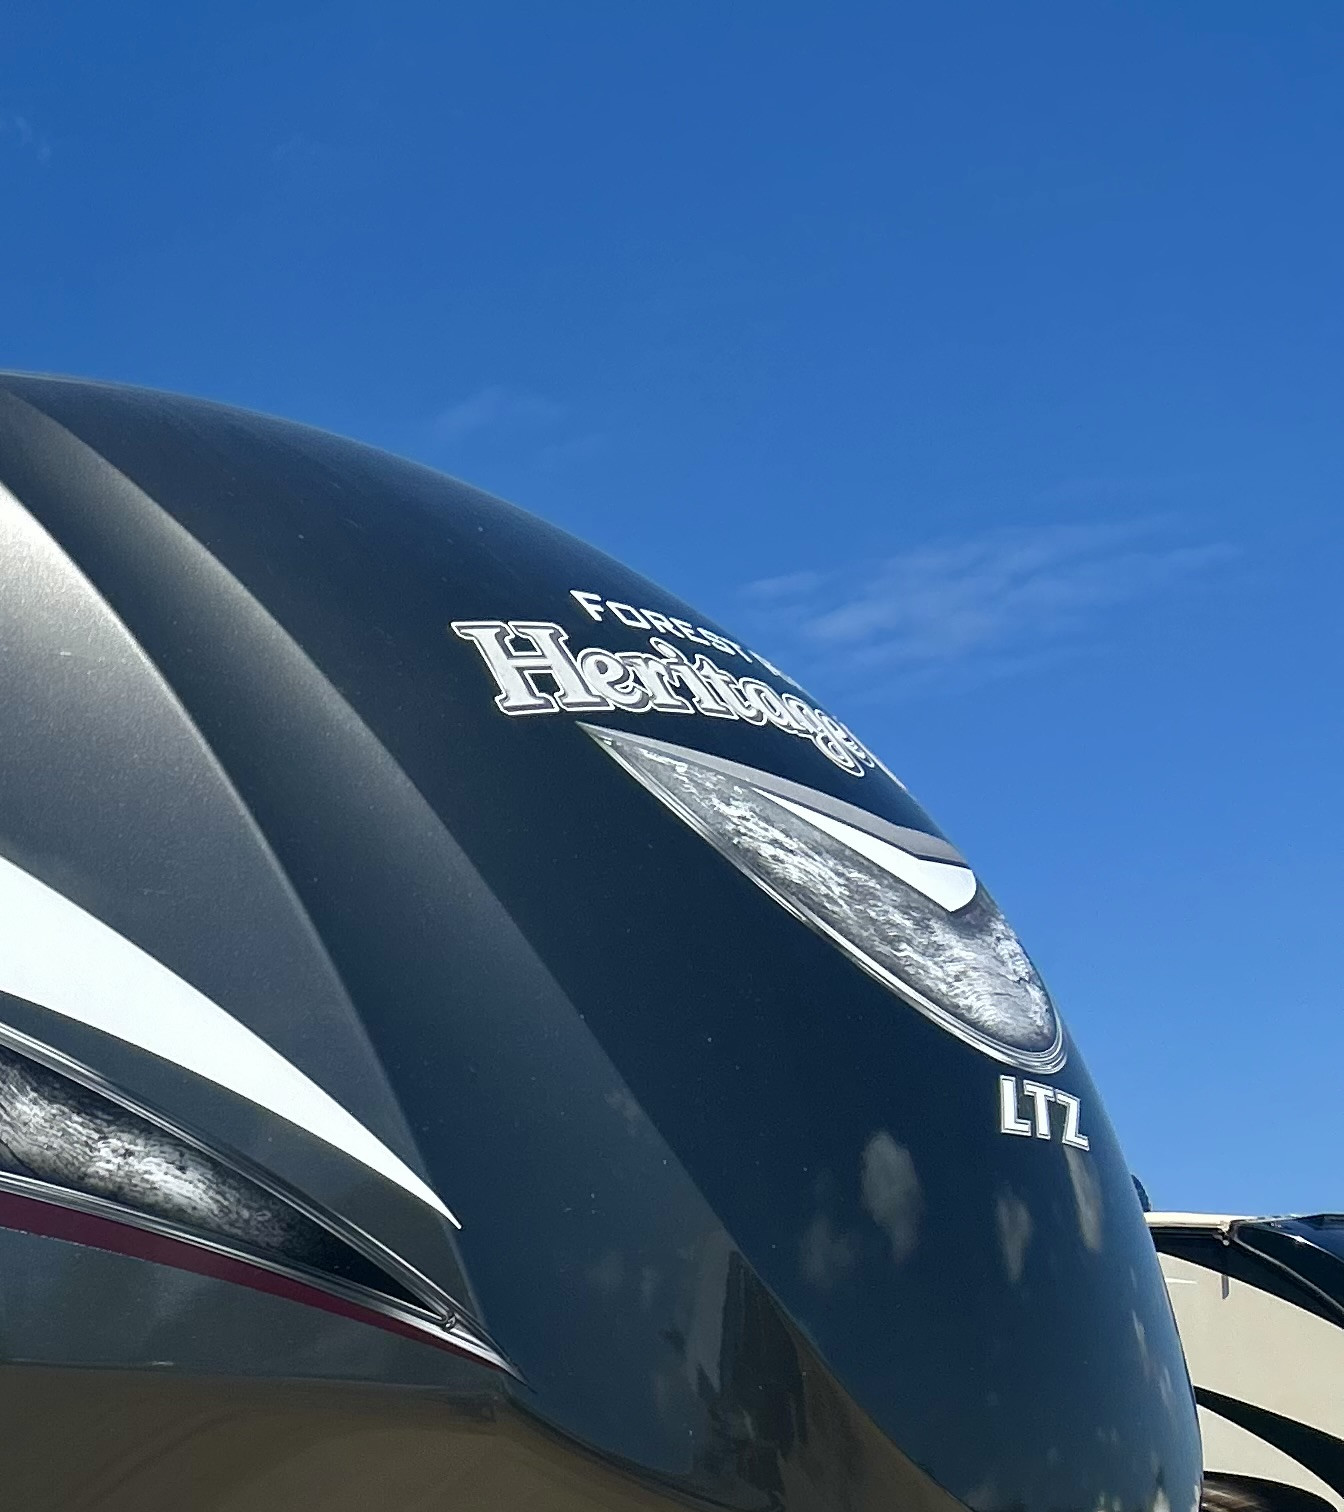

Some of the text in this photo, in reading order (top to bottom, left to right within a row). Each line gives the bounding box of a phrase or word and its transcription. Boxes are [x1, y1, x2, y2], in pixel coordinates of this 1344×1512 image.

[569, 589, 753, 664] FOREST
[450, 620, 875, 777] Heritage
[1000, 1075, 1090, 1151] LTZ
